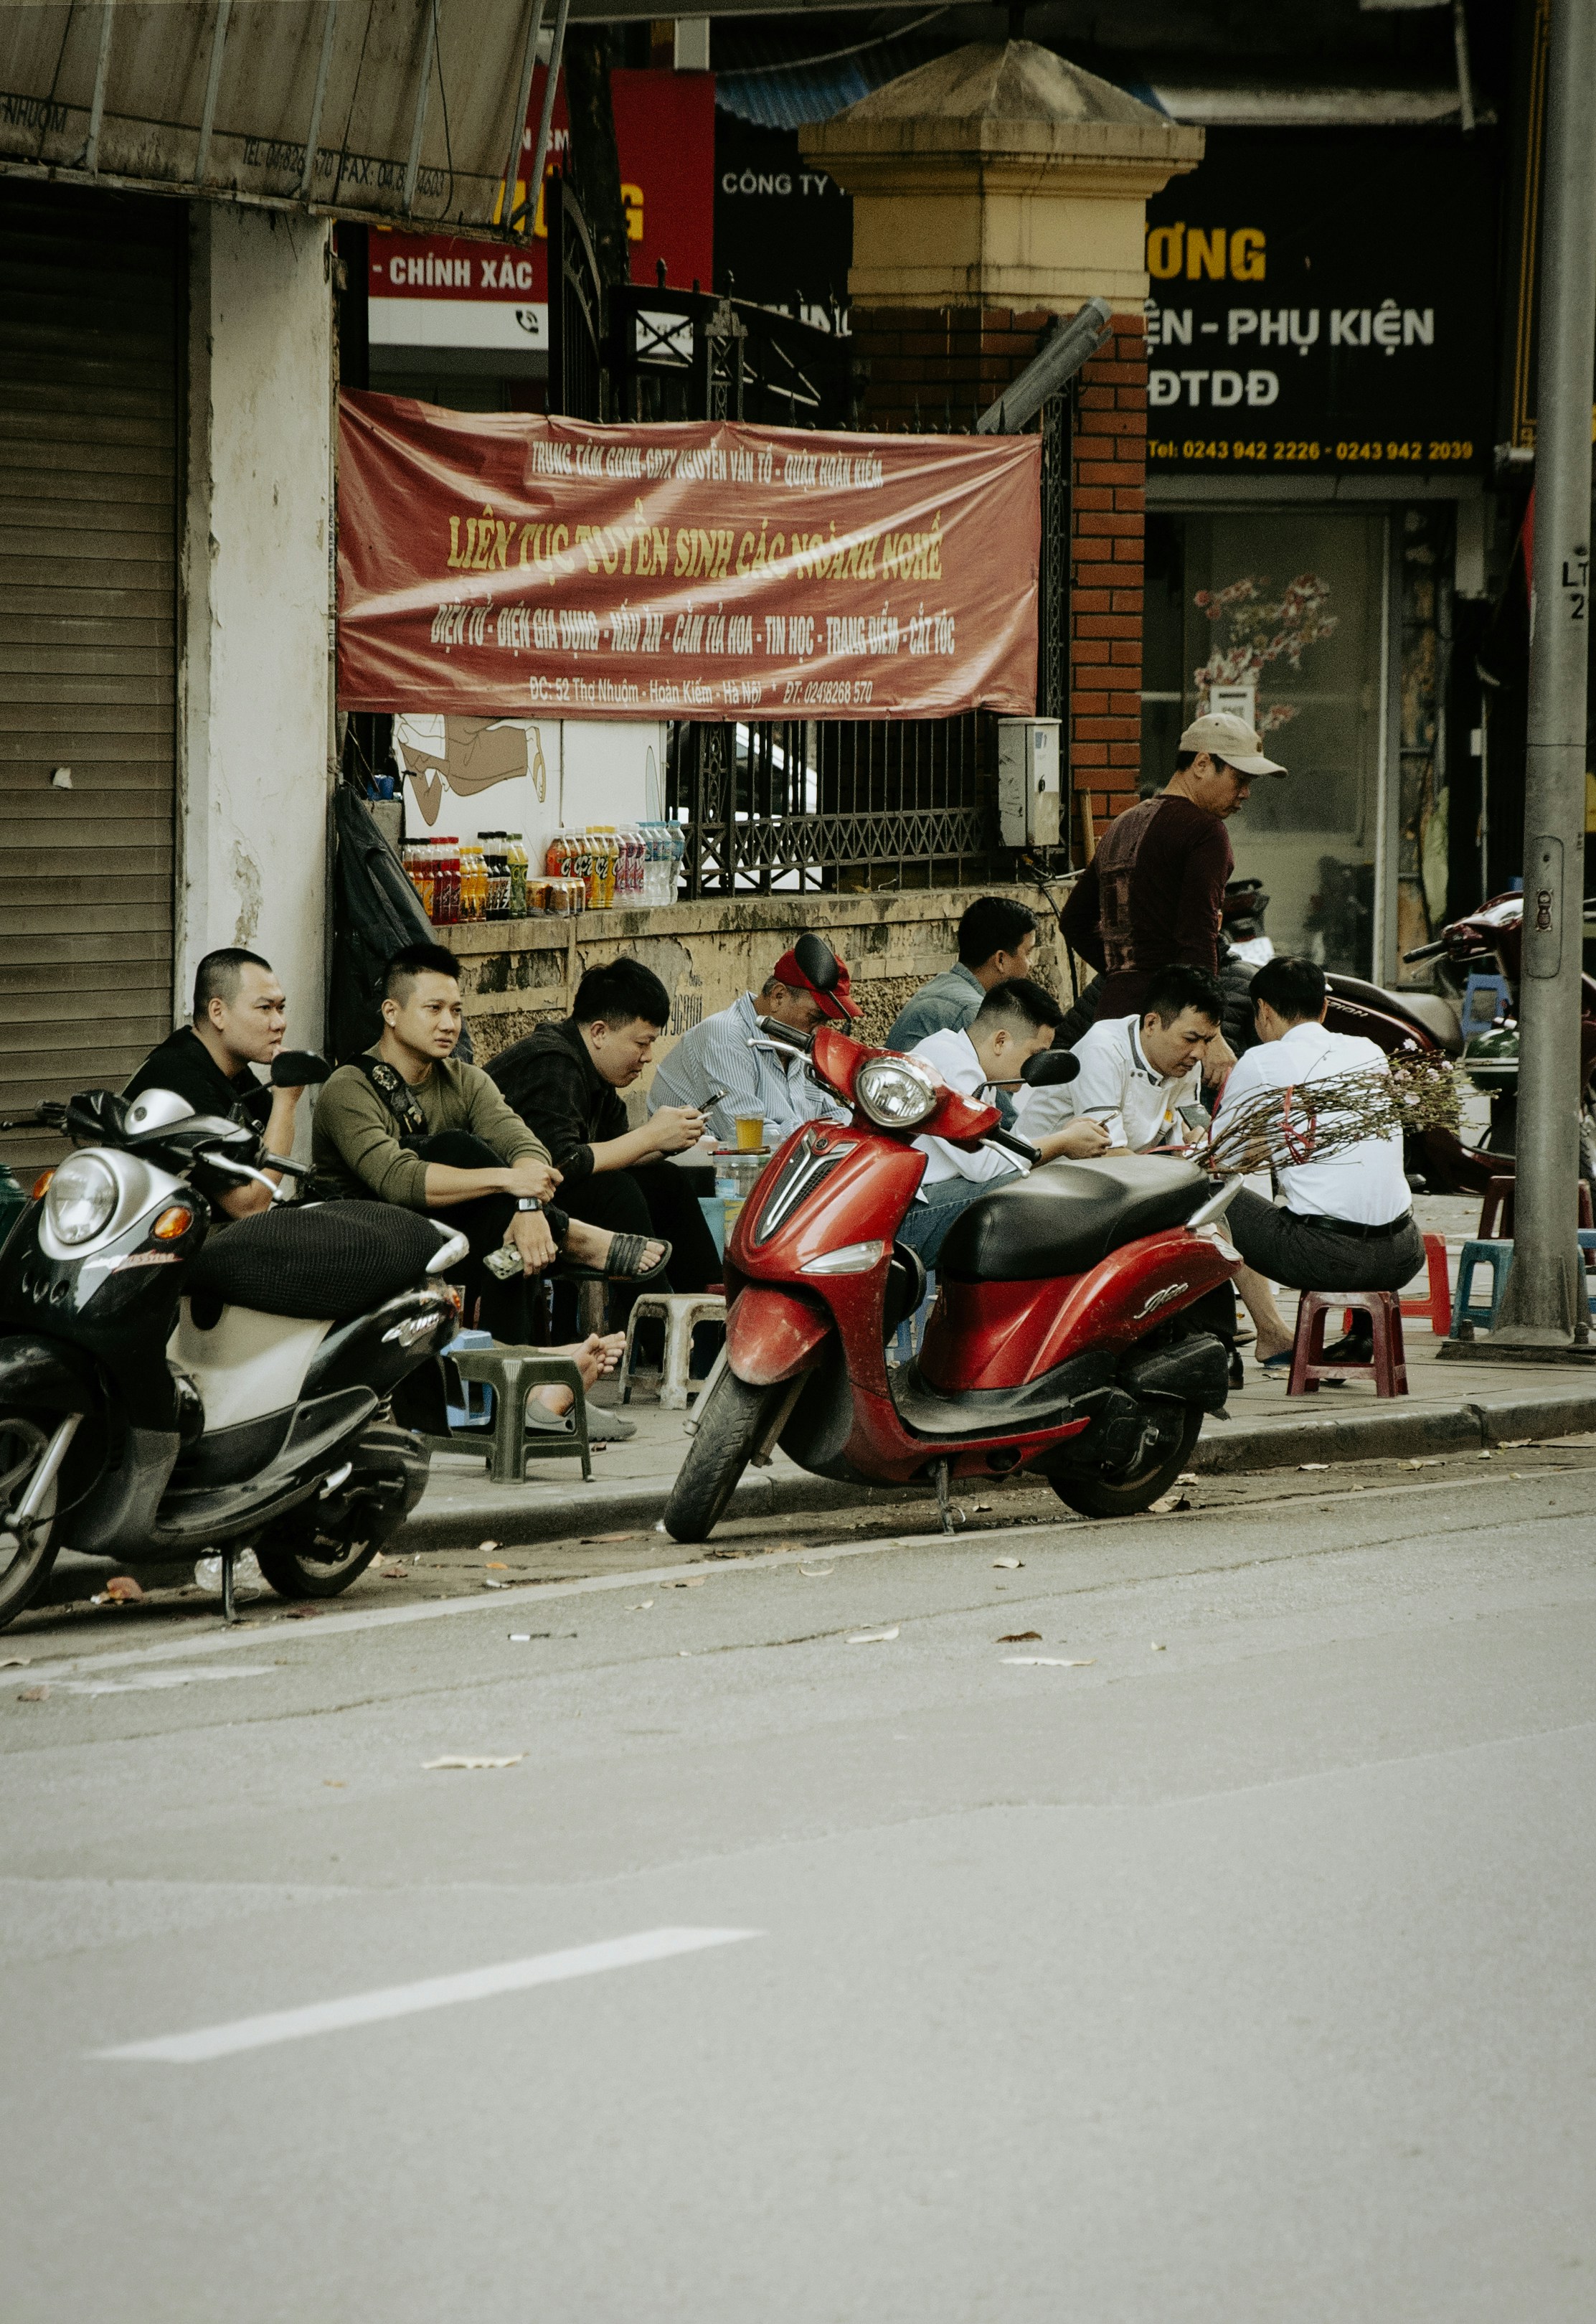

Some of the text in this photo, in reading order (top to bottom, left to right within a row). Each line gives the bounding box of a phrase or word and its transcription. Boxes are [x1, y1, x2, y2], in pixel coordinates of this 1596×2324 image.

[722, 167, 828, 197] CÔNG TY
[1145, 220, 1267, 281] ƠNG
[389, 253, 471, 288] CHÍNH
[481, 255, 533, 290] XÁC
[1227, 308, 1321, 357] PHỤ
[1329, 298, 1435, 357] KIỆN
[1147, 369, 1280, 407] ĐTDĐ
[532, 441, 572, 474] TRUNG
[575, 438, 605, 477] TÂM
[676, 437, 727, 481] NGUYỄN
[729, 445, 754, 483] VĂN
[757, 442, 773, 484] TỐ
[784, 448, 818, 493] QUẬN
[819, 450, 852, 487] HOÀN
[854, 449, 884, 489] KIẾM
[1182, 440, 1229, 459] 0243
[1232, 441, 1267, 460] 942
[1272, 441, 1321, 461] 2226
[1336, 441, 1383, 461] 0243
[1386, 441, 1422, 461] 942
[447, 507, 517, 570] LIÊN
[519, 524, 576, 586] TỤC
[575, 497, 670, 576] TUYỂN
[674, 528, 735, 578] SINH
[736, 517, 789, 580] CÁC
[790, 520, 881, 580] NGÀNH
[1562, 562, 1589, 587] LT
[1570, 593, 1585, 619] 2
[496, 600, 532, 657] ĐIỆN
[532, 608, 559, 649] GIA
[559, 609, 600, 659] DỤNG
[609, 598, 641, 652] NẤU
[641, 604, 664, 652] ĂN
[727, 616, 753, 654] HOA
[765, 616, 785, 654] TIN
[788, 616, 815, 664] HỌC
[826, 616, 867, 654] TRANG
[909, 601, 932, 654] CẮT
[933, 608, 955, 654] TÓC
[529, 676, 553, 701] ĐC:
[555, 677, 570, 701] 52
[572, 677, 595, 707] Thợ
[598, 678, 639, 708] Nhuộm
[649, 678, 680, 703] Hoàn
[683, 677, 713, 704] Kiếm
[722, 680, 740, 704] Hà
[742, 680, 762, 709] Nội
[853, 680, 873, 704] 570
